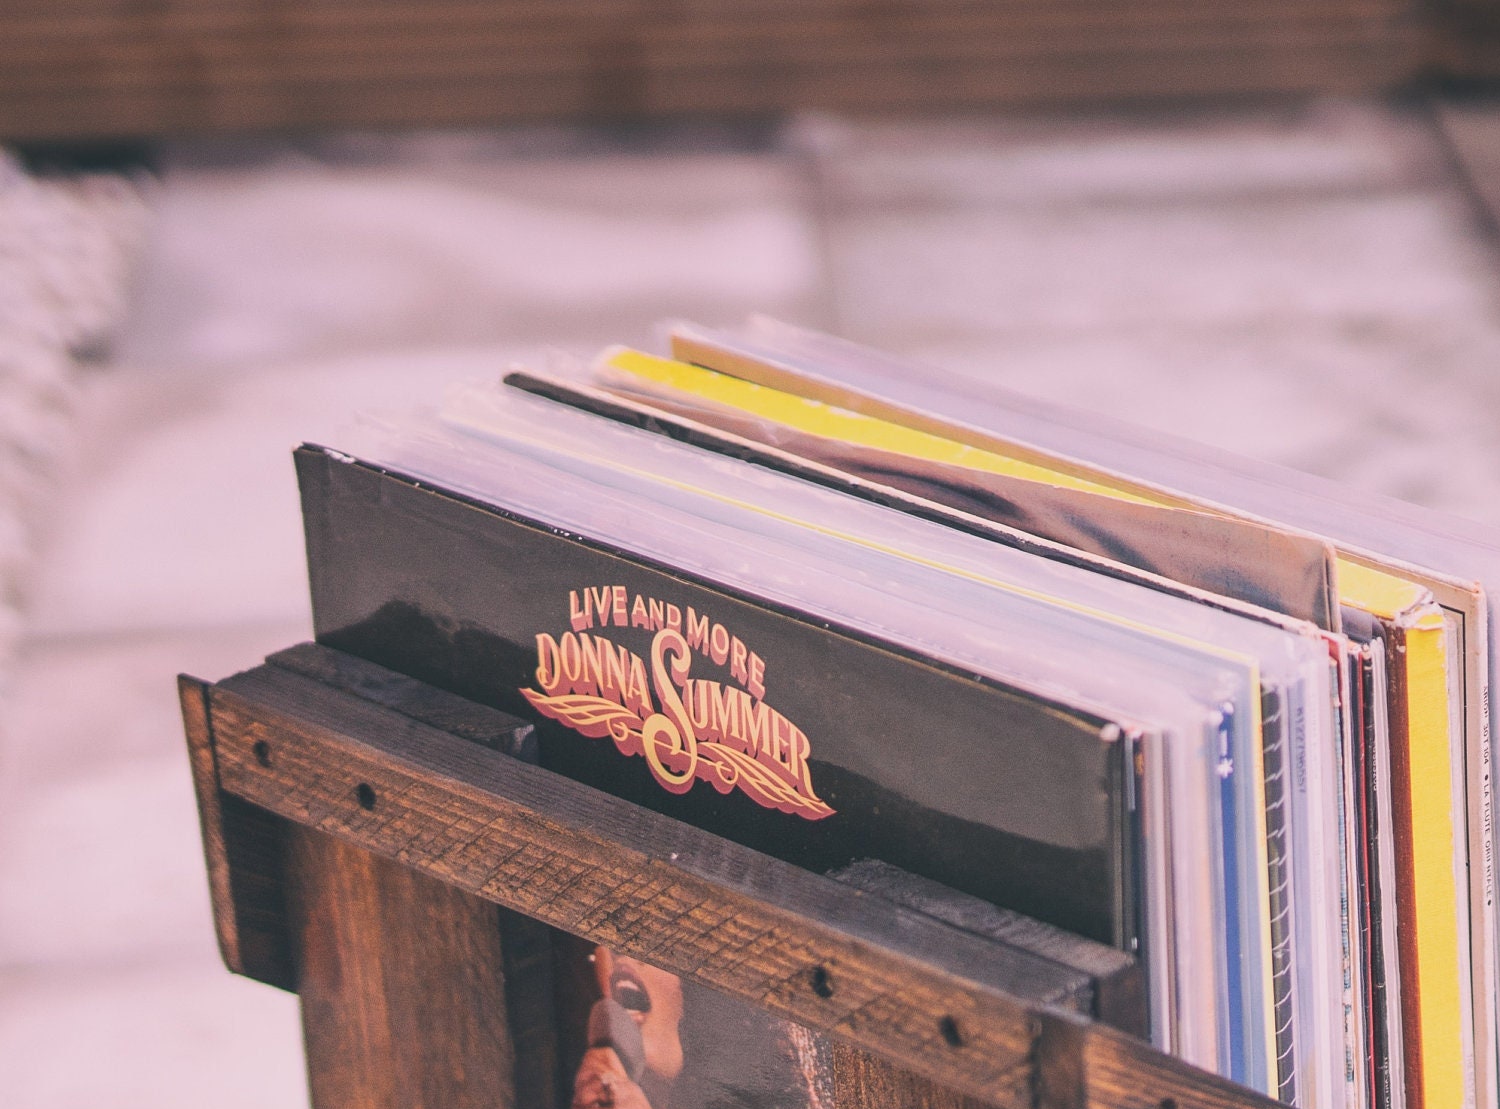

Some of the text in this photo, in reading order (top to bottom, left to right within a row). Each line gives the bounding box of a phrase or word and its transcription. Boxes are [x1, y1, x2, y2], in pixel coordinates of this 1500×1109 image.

[534, 628, 822, 800] DONNA SUMMER
[569, 585, 766, 701] LIVE AND MORE
